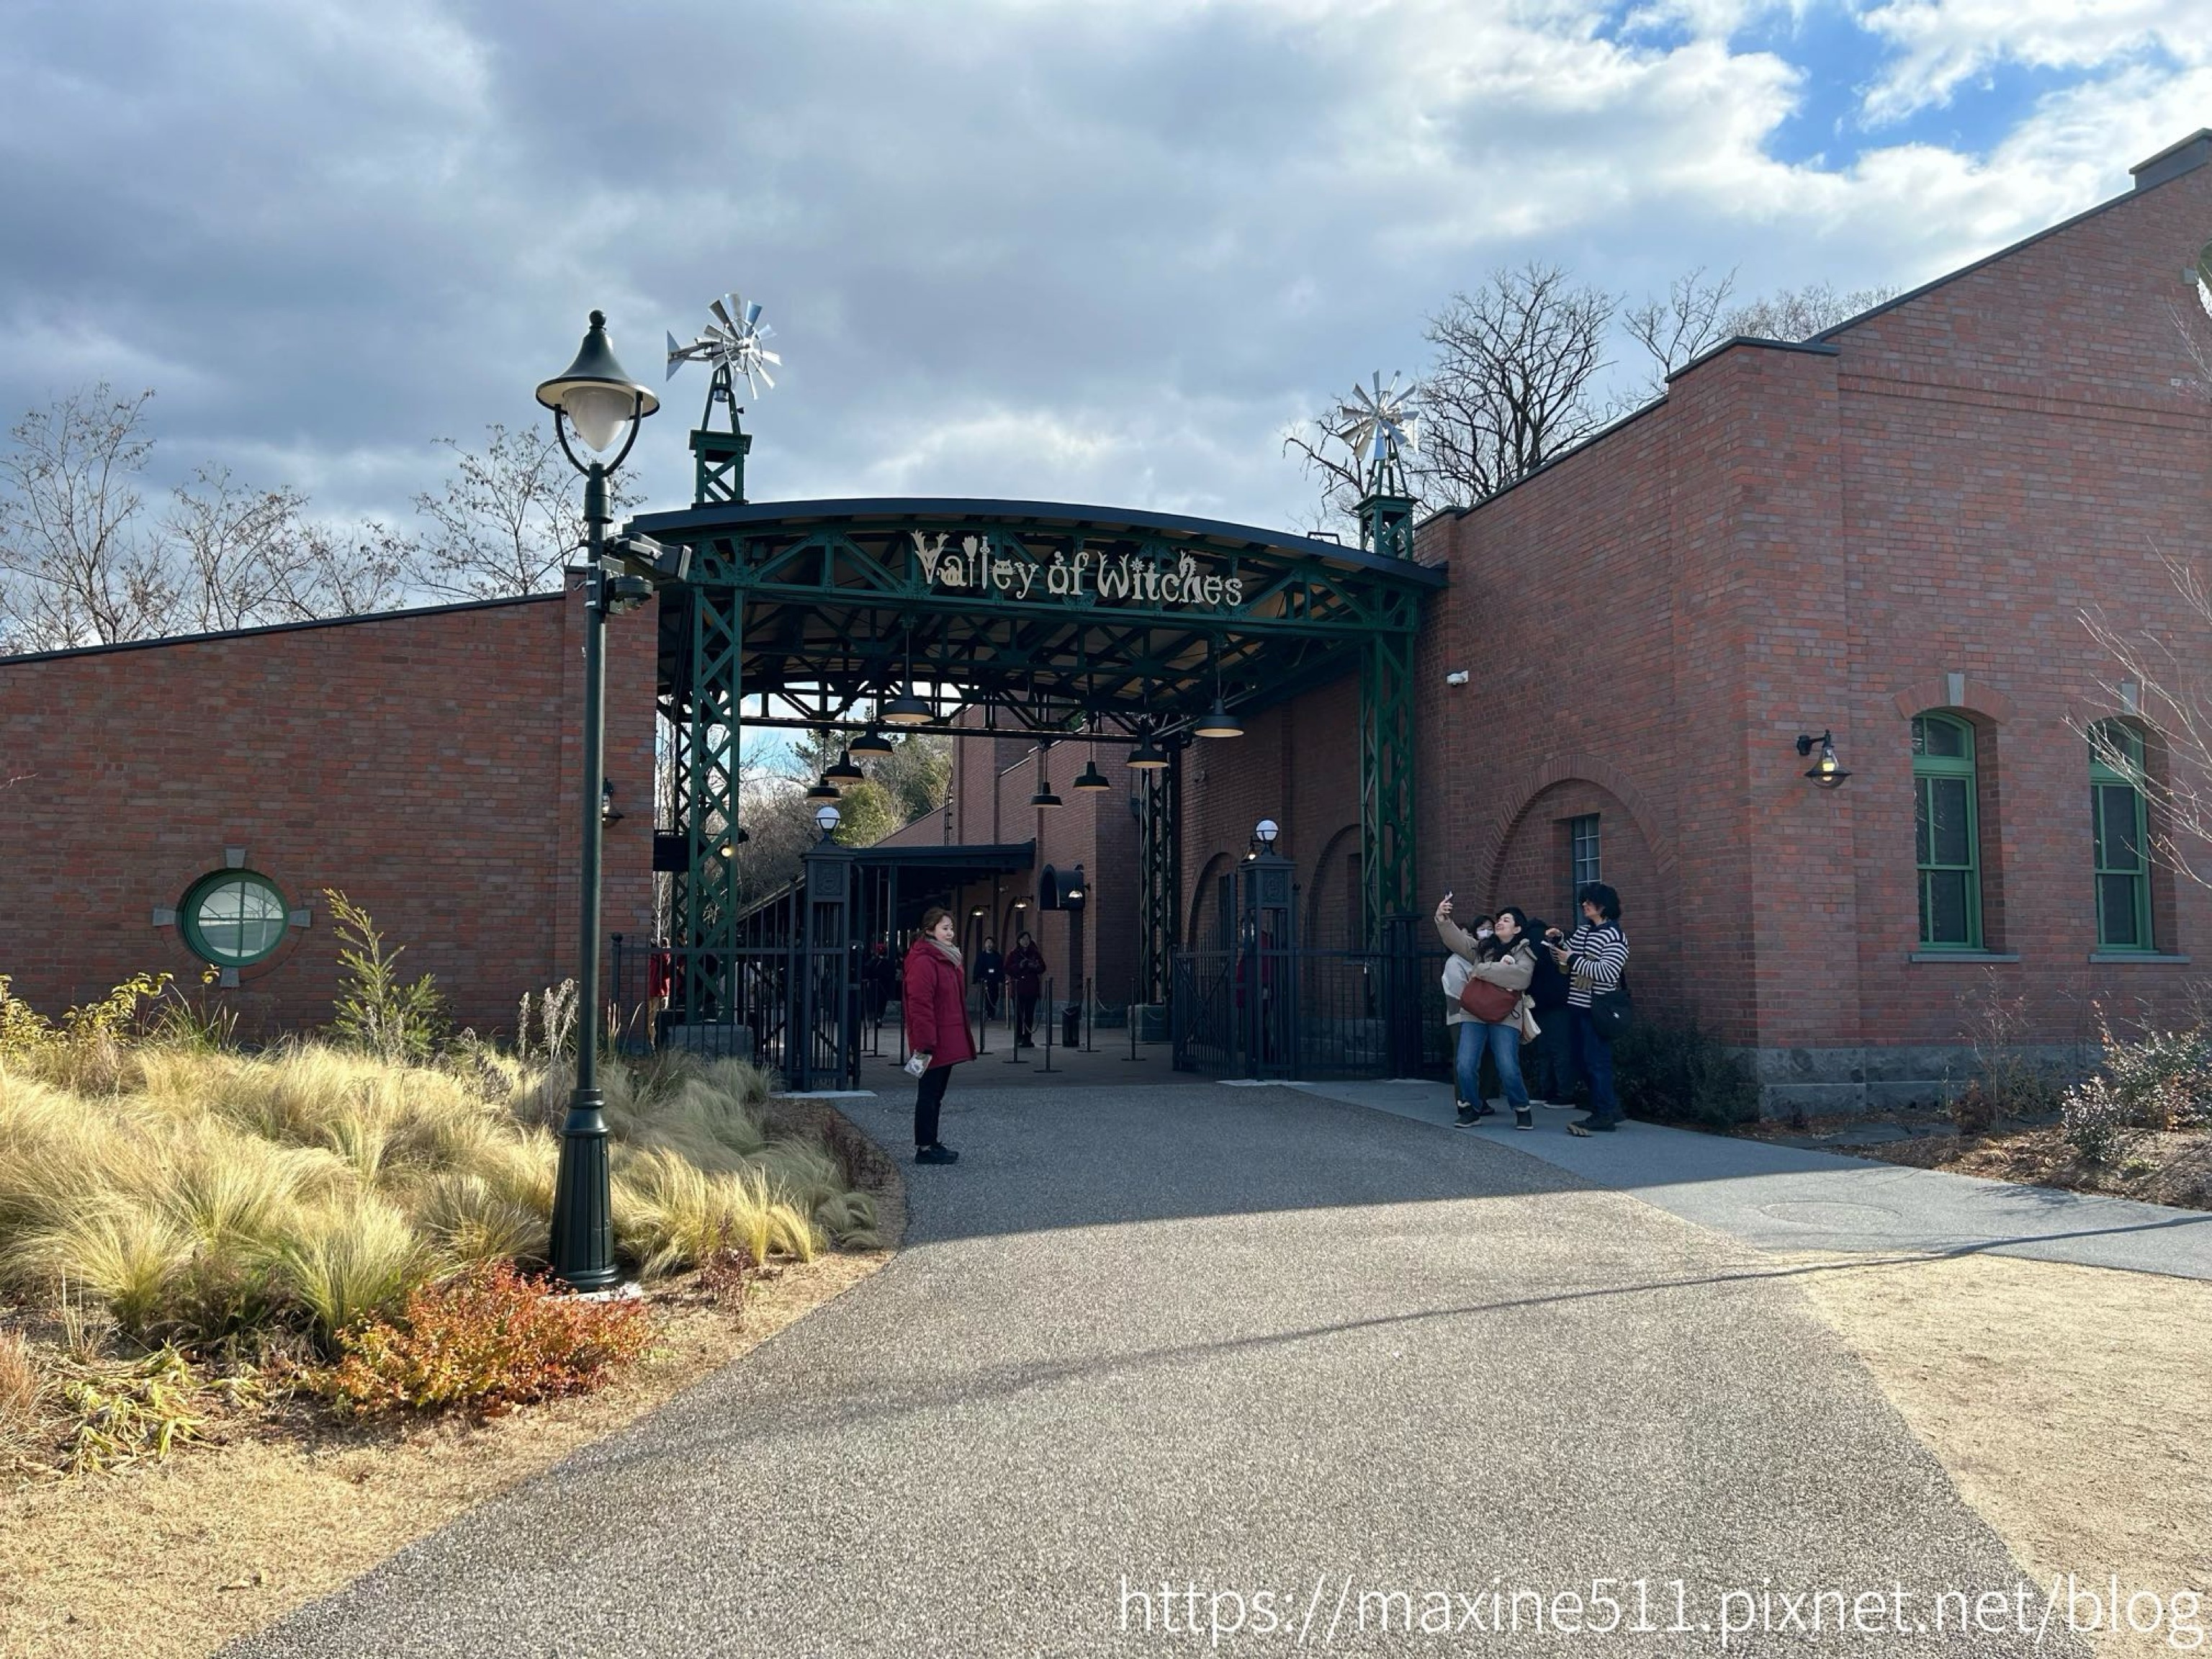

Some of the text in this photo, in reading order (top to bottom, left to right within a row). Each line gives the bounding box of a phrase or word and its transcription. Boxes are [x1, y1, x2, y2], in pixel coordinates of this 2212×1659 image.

[911, 529, 1243, 606] Valley of Witches
